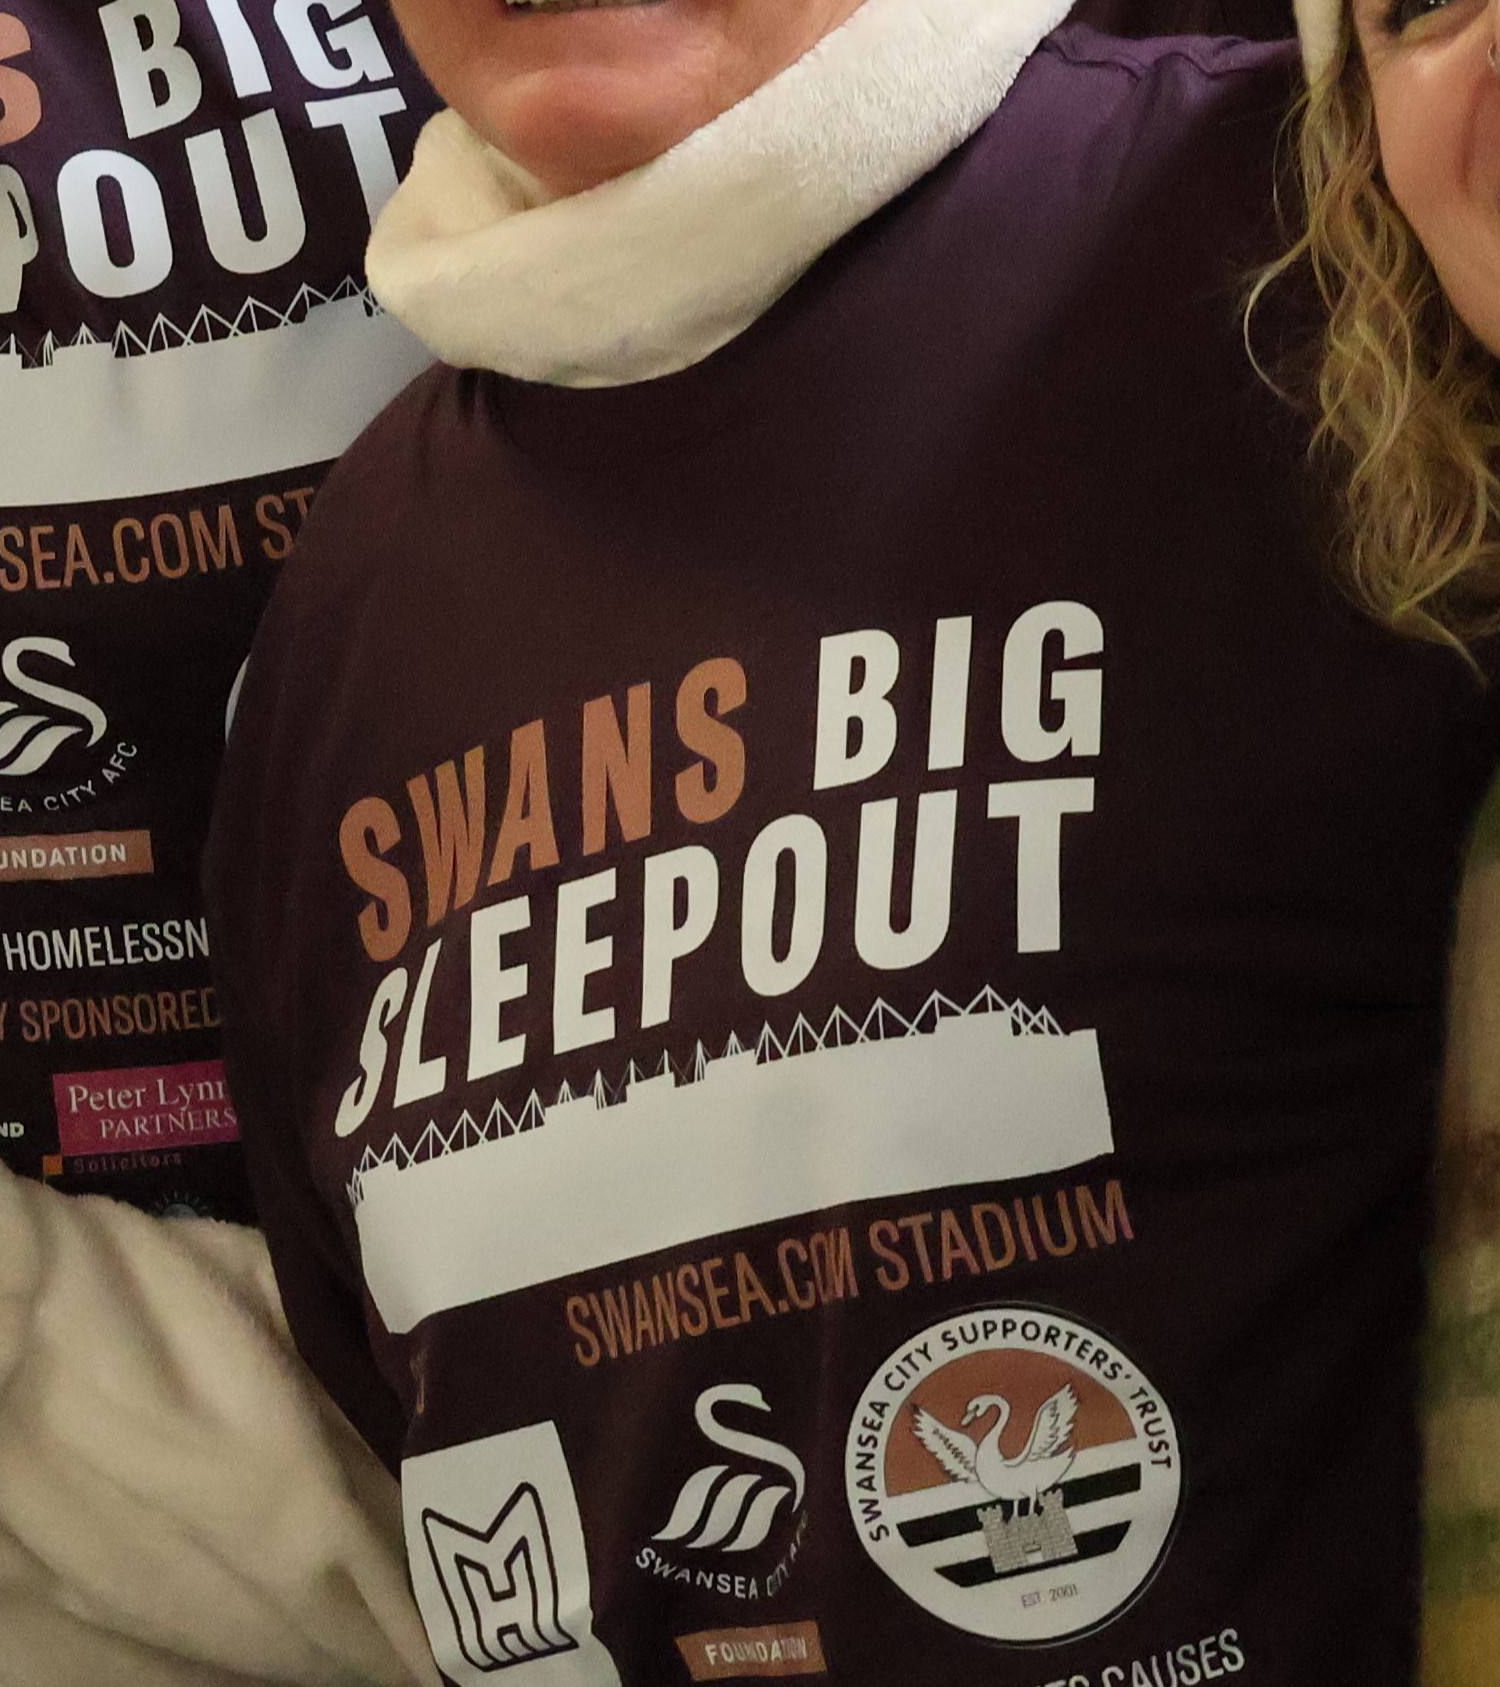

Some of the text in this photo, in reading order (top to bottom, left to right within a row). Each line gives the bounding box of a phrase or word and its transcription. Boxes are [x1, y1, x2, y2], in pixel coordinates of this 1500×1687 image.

[43, 779, 97, 812] CITY
[102, 741, 138, 785] AFC
[338, 600, 1105, 962] SWANS BIG
[335, 777, 1096, 1138] SLEEPOUT
[68, 1084, 146, 1114] Peter
[101, 1107, 238, 1140] PARTNERS
[868, 1179, 1134, 1292] STADIUM
[856, 1318, 1172, 1542] SWANSEA CITY SUPPORTERS' TRUST
[635, 1546, 758, 1599] SWANSEA
